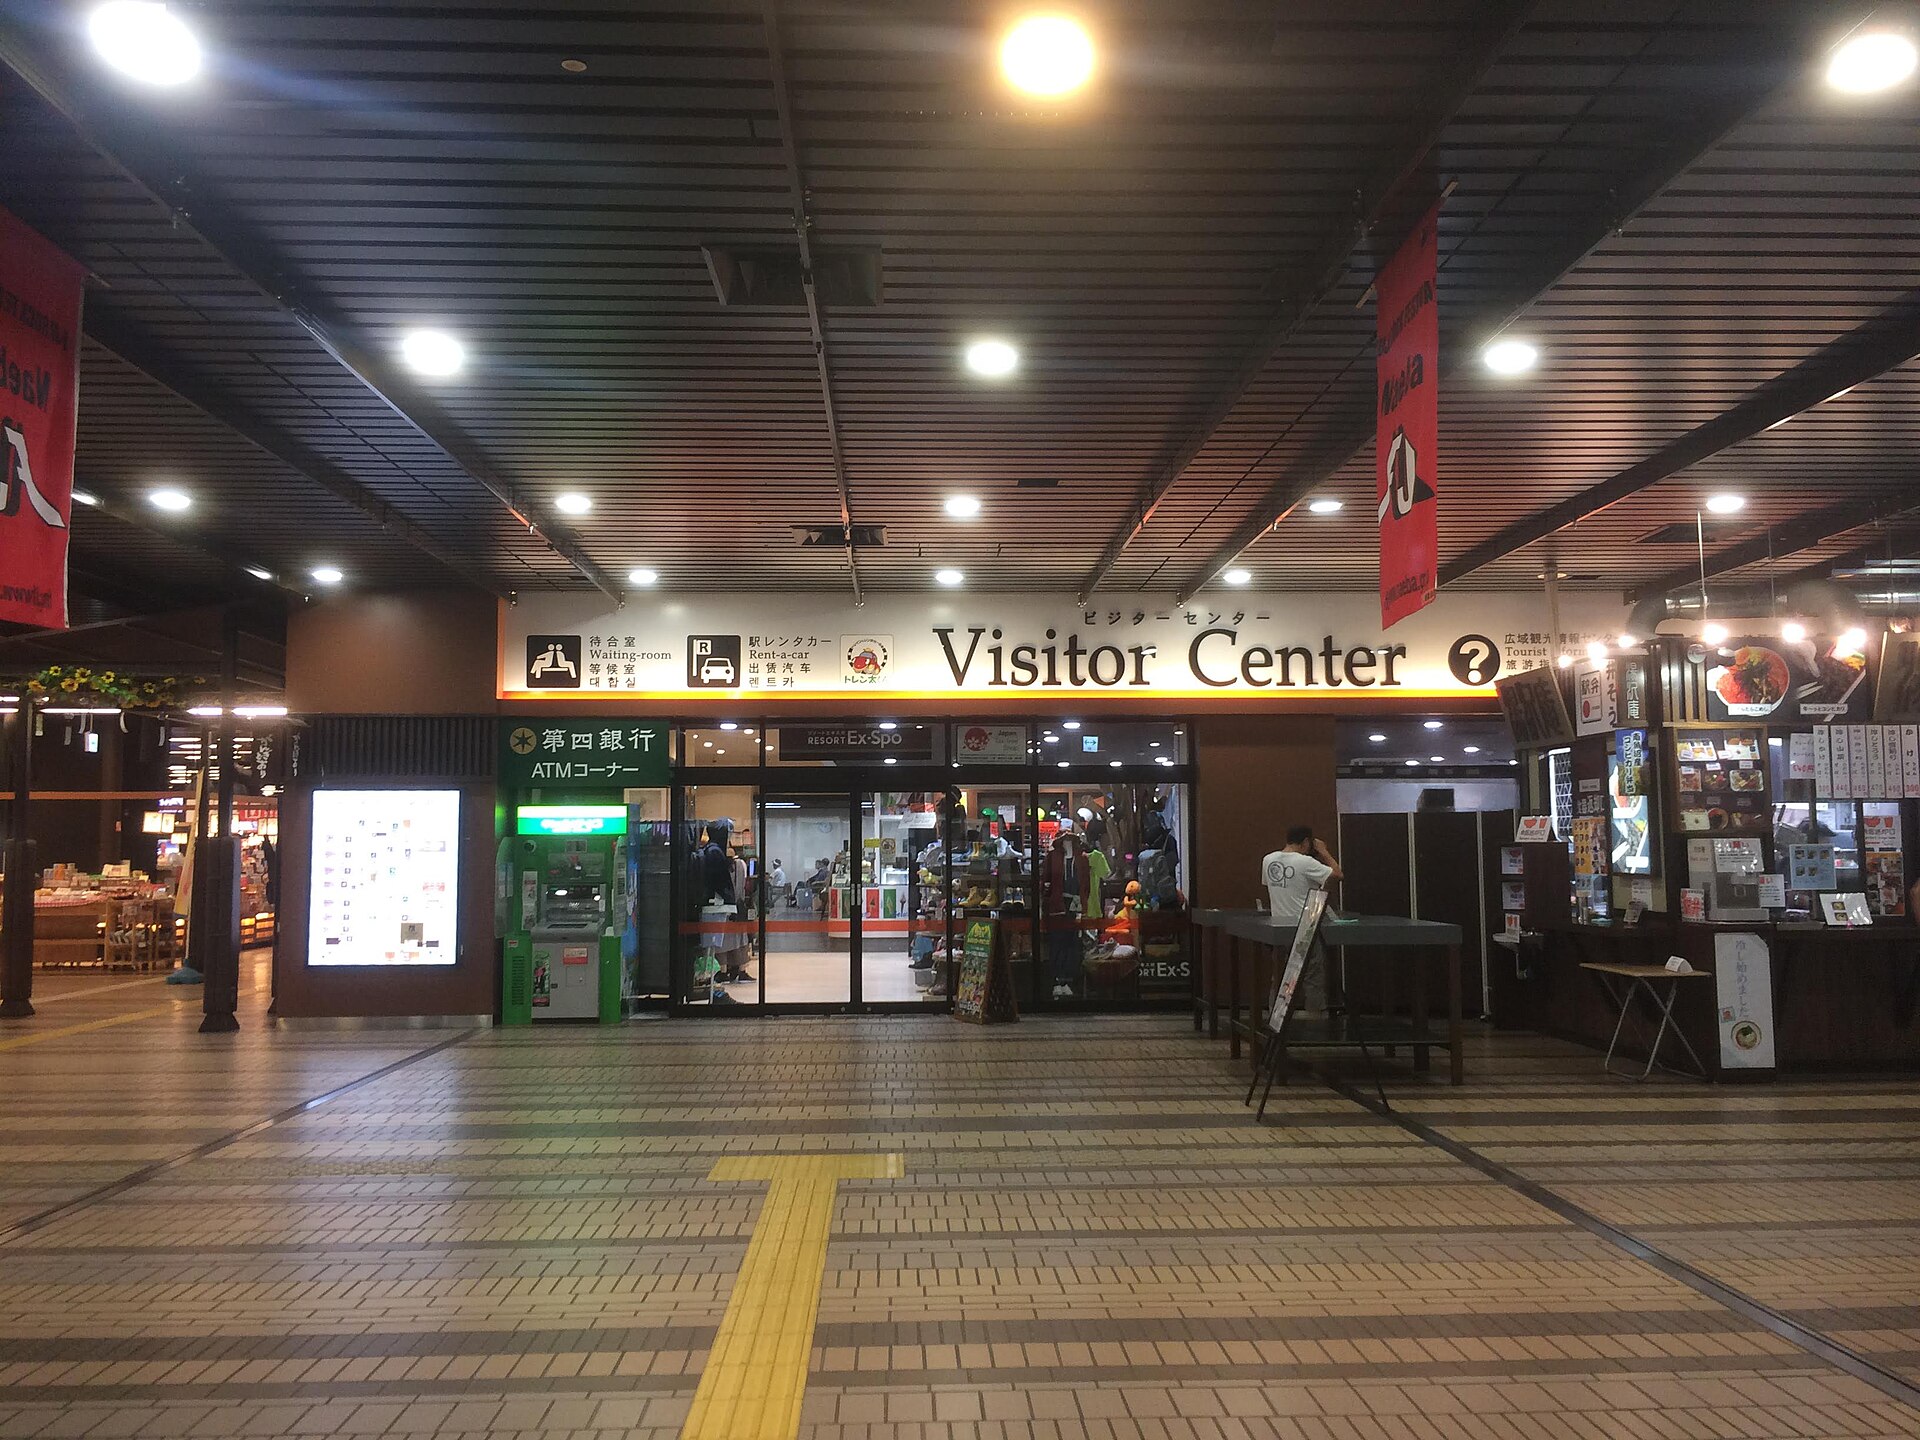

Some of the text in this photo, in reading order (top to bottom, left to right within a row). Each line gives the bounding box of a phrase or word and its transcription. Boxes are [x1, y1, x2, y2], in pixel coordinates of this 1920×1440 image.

[1084, 610, 1271, 626] ビジターセンター
[589, 635, 636, 648] 待合室
[749, 635, 832, 648] 駅レンタカー
[1504, 632, 1618, 645] 広域観光情報センタ
[589, 649, 672, 661] Waiting-room
[749, 649, 810, 660] Rent-a-car
[932, 627, 1407, 687] Visitor Center
[1505, 646, 1546, 657] Tourist
[589, 663, 636, 675] 等候室
[589, 676, 636, 688] 대합실
[749, 676, 795, 688] 렌트카
[541, 727, 655, 753] 第四銀行
[808, 736, 846, 745] RESORT
[531, 762, 639, 779] ATMコーナー
